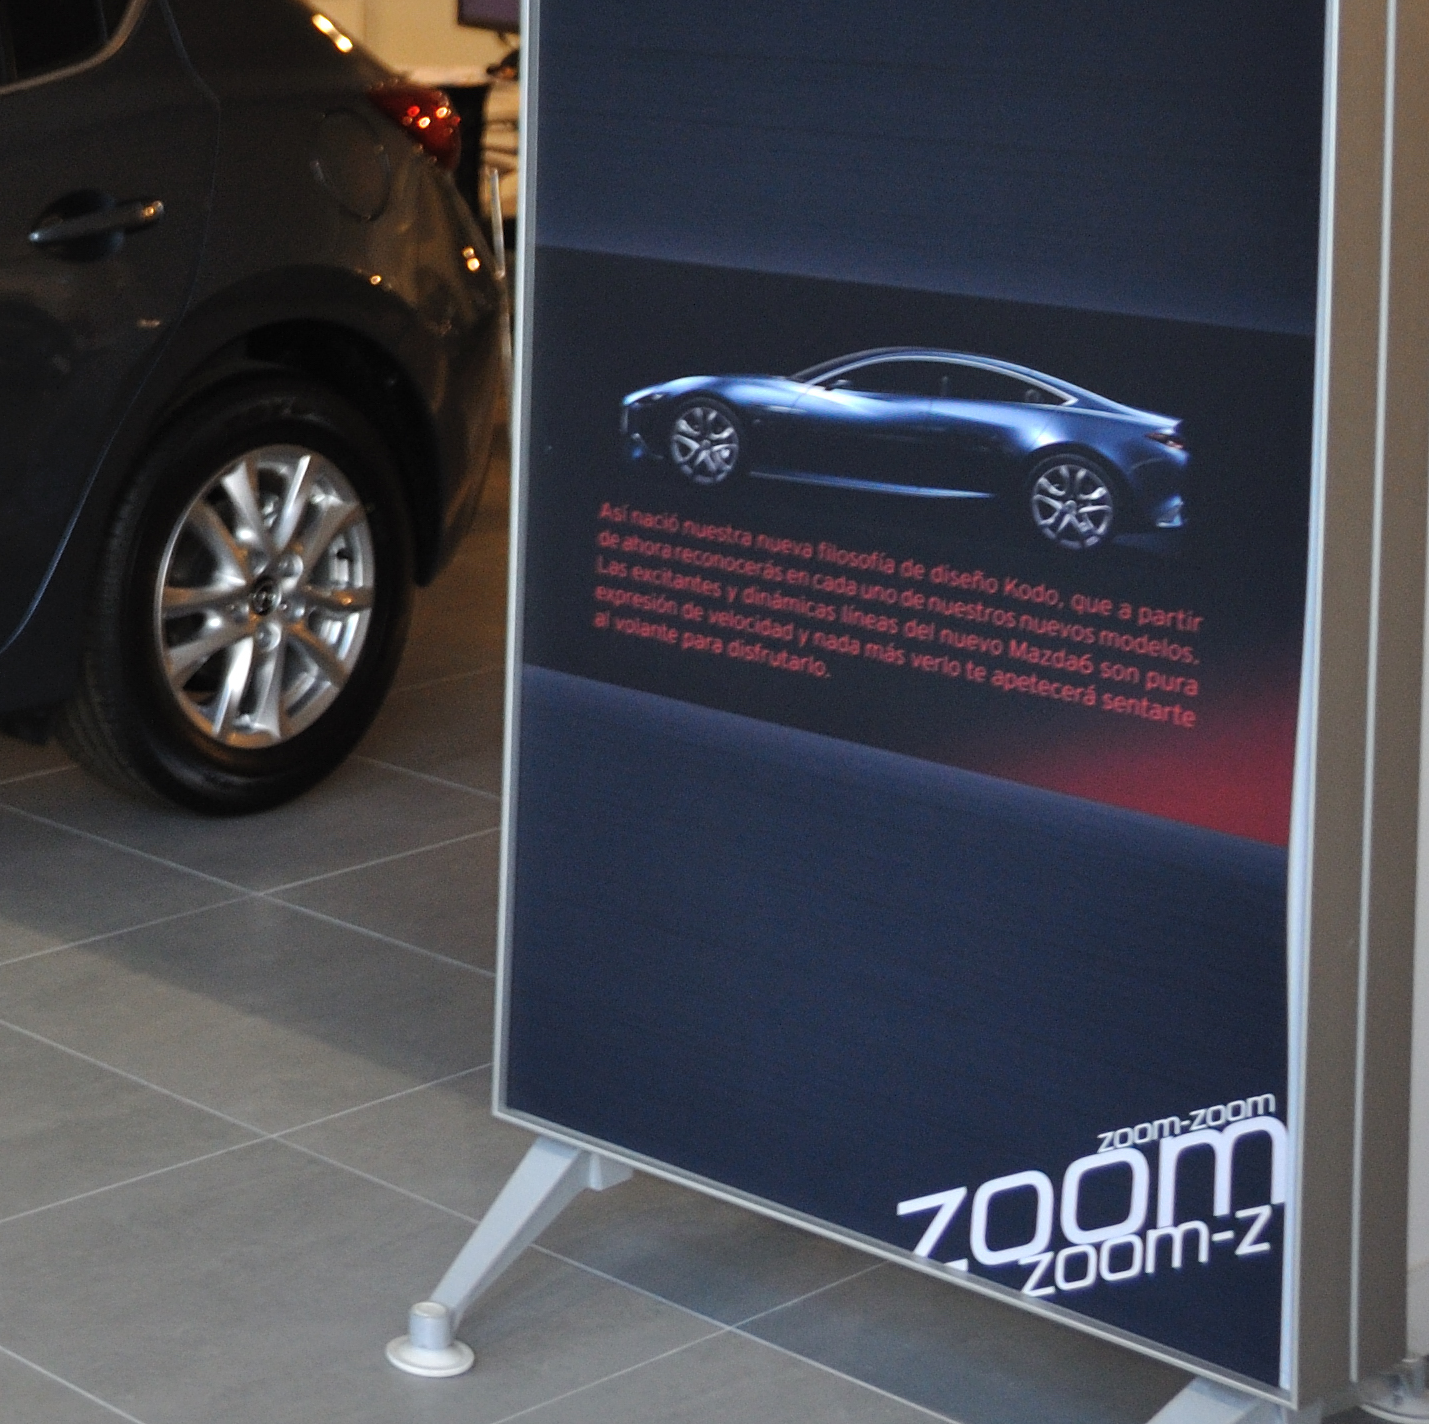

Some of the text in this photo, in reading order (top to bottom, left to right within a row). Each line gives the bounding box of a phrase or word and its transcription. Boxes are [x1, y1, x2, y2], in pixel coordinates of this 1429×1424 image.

[597, 556, 1199, 697] Las excitantes y dinámicas líneas del nuevo Mazda6 son pura
[598, 531, 1200, 665] de ahora reconocerás en cada uno de nuestros nuevos modelos.
[599, 502, 1204, 632] Así nació nuestra nueva filosofía de diseño Kodo, que a partir
[594, 611, 831, 677] al volante para disfrutarlo.
[594, 585, 1197, 727] expresión de velocidad y nada más verlo te apetecerá sentarte
[1098, 1092, 1276, 1153] zoom-zoom
[897, 1116, 1291, 1272] zoom
[1020, 1205, 1273, 1297] zoom-z
